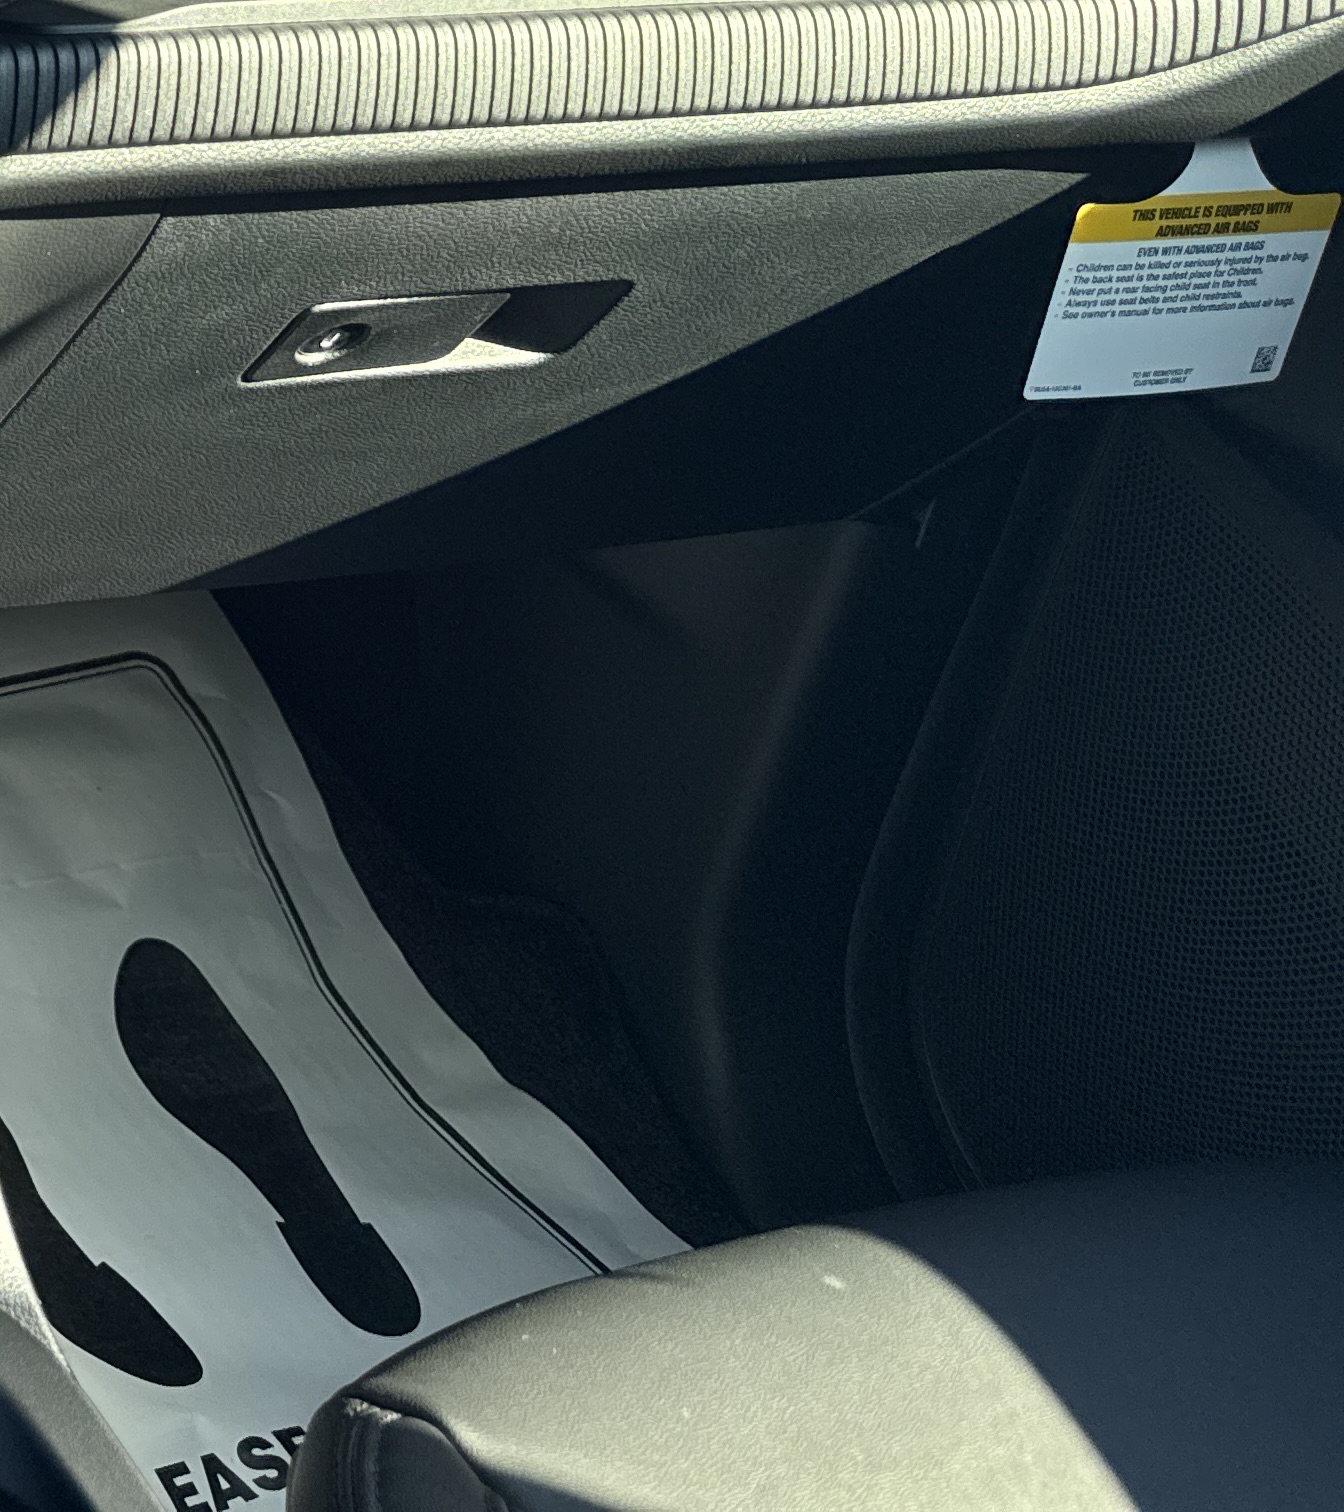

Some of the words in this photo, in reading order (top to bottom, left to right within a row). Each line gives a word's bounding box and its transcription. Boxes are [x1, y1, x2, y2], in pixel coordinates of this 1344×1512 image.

[1132, 208, 1156, 221] THIS
[1158, 206, 1200, 221] VEHICLE
[1202, 205, 1213, 218] IS
[1214, 202, 1265, 218] EQUIPPED
[1266, 201, 1294, 215] WITH
[1155, 223, 1211, 238] ADVANCED
[1212, 221, 1231, 235] AIR
[1232, 220, 1261, 233] BAGS
[1137, 246, 1160, 258] EVEN
[1161, 245, 1183, 256] WITH
[1183, 243, 1227, 255] ADVANCED
[1227, 241, 1243, 252] AIR
[1243, 240, 1266, 251] BAGS
[1076, 263, 1113, 273] Children
[1116, 263, 1133, 272] can
[1135, 262, 1147, 271] be
[1148, 260, 1171, 270] killed
[1183, 257, 1223, 268] seriously
[1254, 254, 1265, 265] by
[1266, 253, 1279, 263] the
[1280, 252, 1292, 262] air
[1073, 275, 1090, 285] The
[1091, 275, 1113, 285] back
[1115, 274, 1134, 283] seat
[1146, 272, 1160, 282] the
[1189, 270, 1212, 281] place
